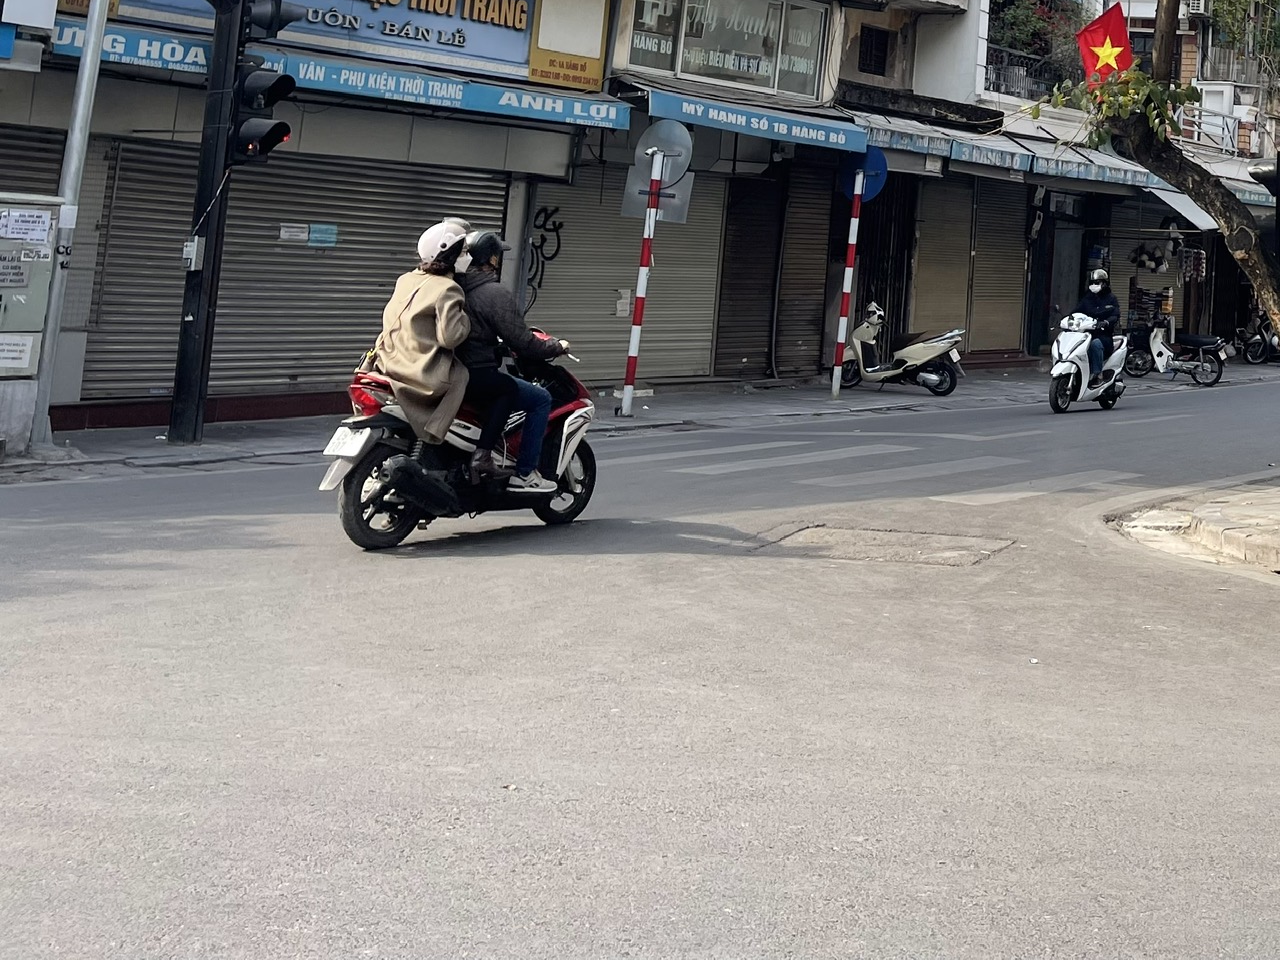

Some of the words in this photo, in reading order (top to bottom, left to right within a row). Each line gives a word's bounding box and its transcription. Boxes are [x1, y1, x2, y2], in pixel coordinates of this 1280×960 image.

[306, 6, 361, 29] UÔN
[384, 19, 432, 41] BÁN
[138, 38, 207, 65] HÒA
[633, 32, 658, 53] HÀNG
[298, 61, 326, 81] VÂN
[340, 69, 365, 90] PHỤ
[368, 71, 396, 93] KIỆN
[399, 76, 425, 94] THỜI
[427, 81, 464, 100] TRANG
[498, 91, 564, 113] ANH
[573, 102, 617, 121] LỢI
[708, 107, 747, 126] HẠNH
[772, 122, 788, 135] 1B
[791, 125, 826, 141] HÀNG
[962, 147, 970, 160] 3
